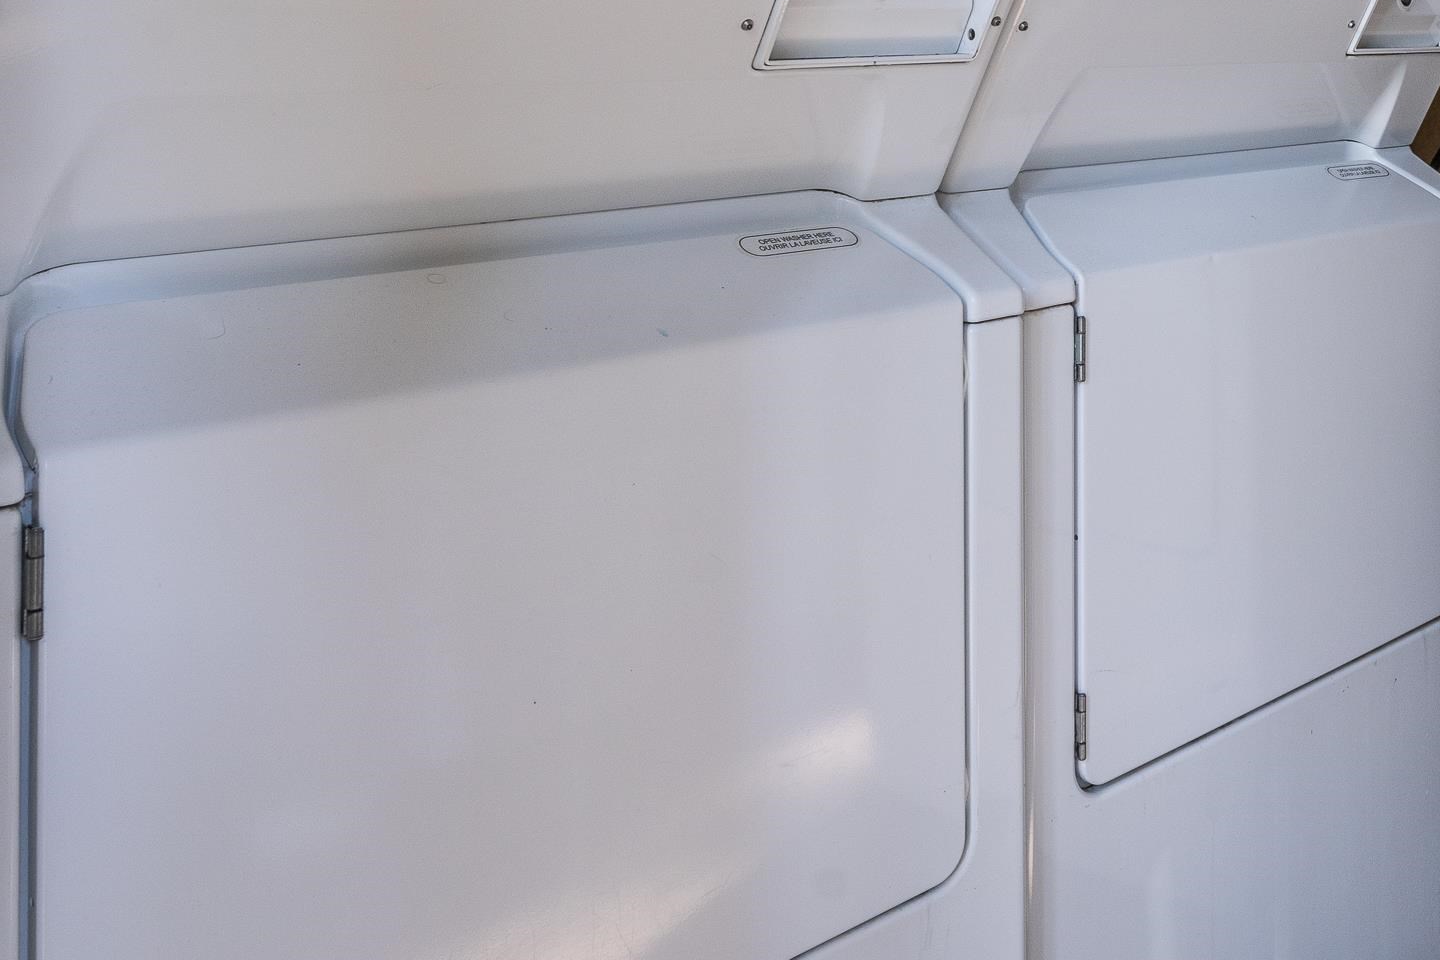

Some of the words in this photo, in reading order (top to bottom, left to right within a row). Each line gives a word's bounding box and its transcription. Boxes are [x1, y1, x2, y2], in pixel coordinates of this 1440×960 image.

[758, 237, 780, 245] OPEN
[780, 233, 813, 242] WASHER
[813, 231, 835, 239] HERE
[759, 243, 789, 251] OUVRIR
[800, 238, 832, 247] LAVEUSE
